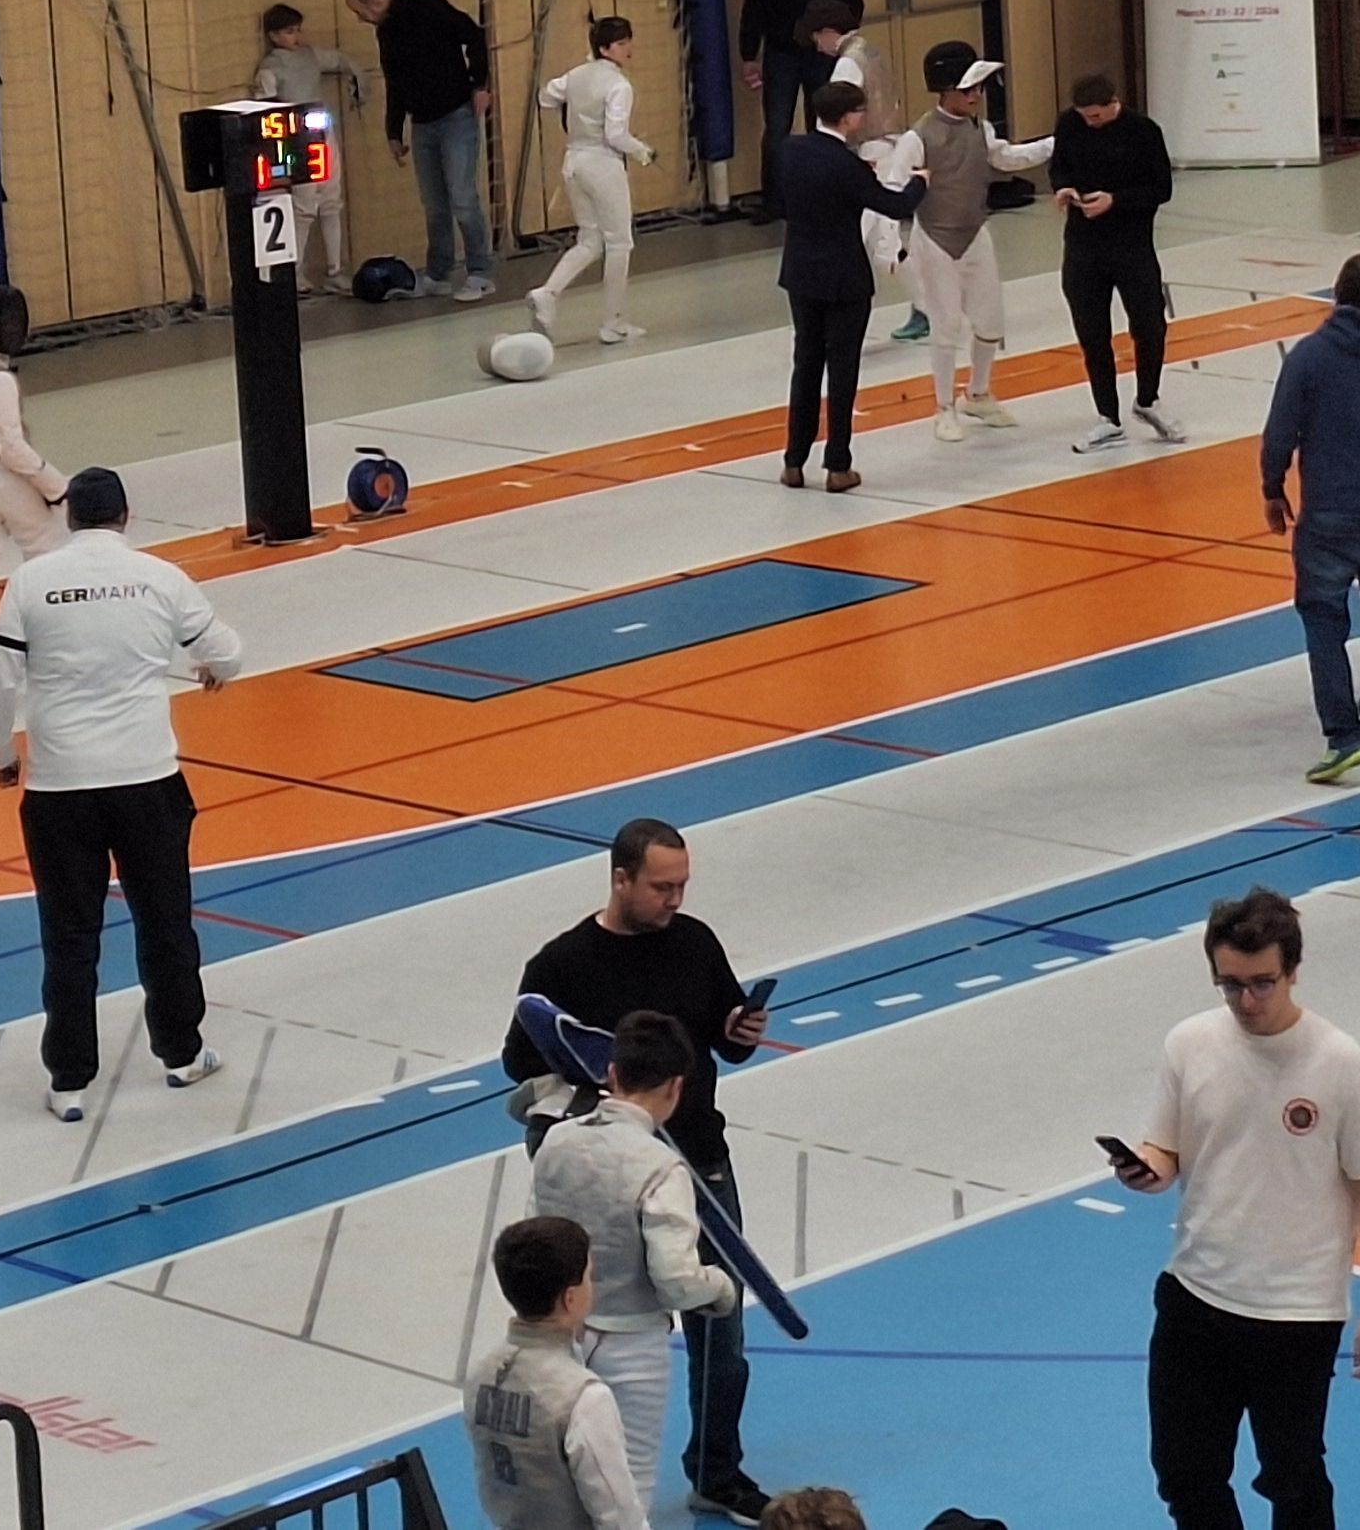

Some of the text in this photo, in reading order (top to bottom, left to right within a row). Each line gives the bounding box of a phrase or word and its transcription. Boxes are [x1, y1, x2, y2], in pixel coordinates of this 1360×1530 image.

[306, 143, 326, 180] 3
[263, 206, 286, 253] 2
[45, 583, 149, 605] GERMANY
